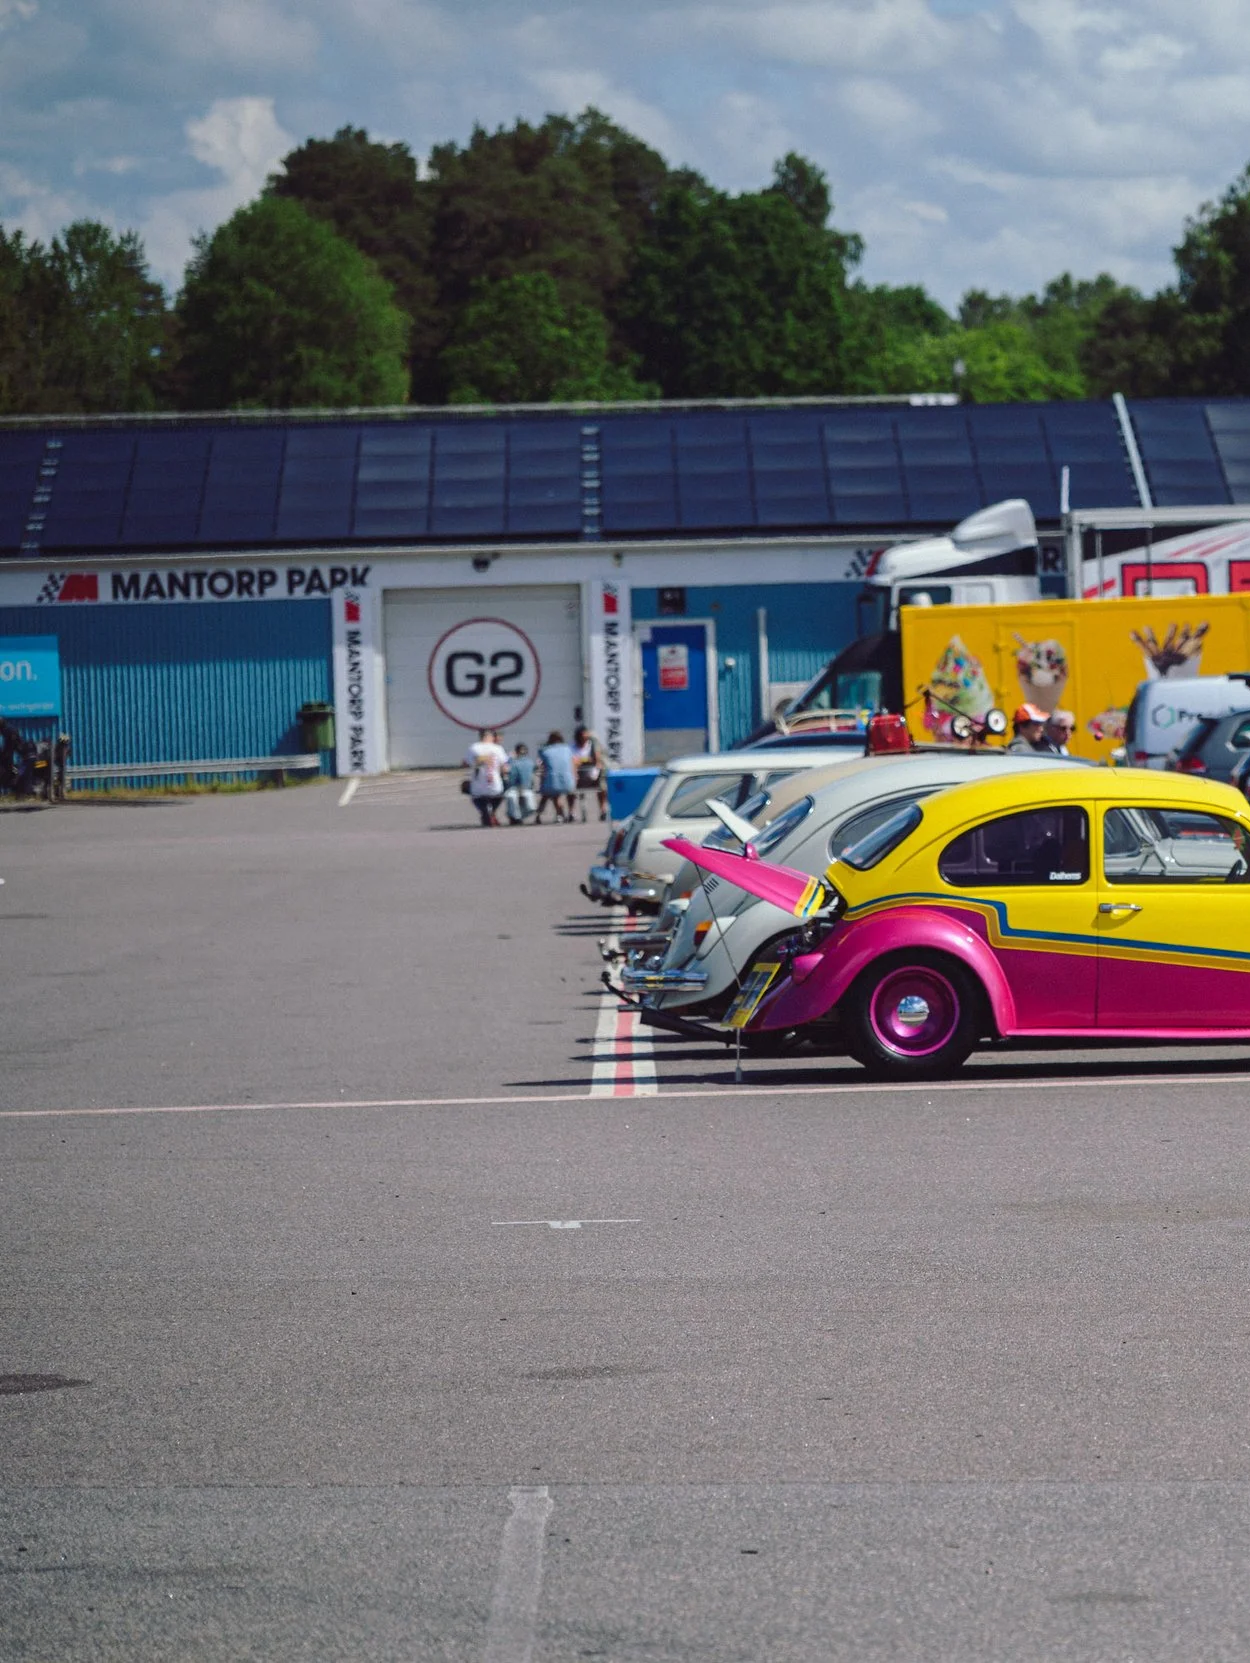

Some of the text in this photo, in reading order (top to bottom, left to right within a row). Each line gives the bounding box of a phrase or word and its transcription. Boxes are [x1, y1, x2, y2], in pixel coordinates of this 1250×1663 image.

[111, 568, 278, 601] MANTORP
[287, 565, 371, 597] PARK
[347, 630, 366, 772] MANTORP PARK
[445, 650, 525, 697] G2
[605, 621, 621, 713] MANTORP
